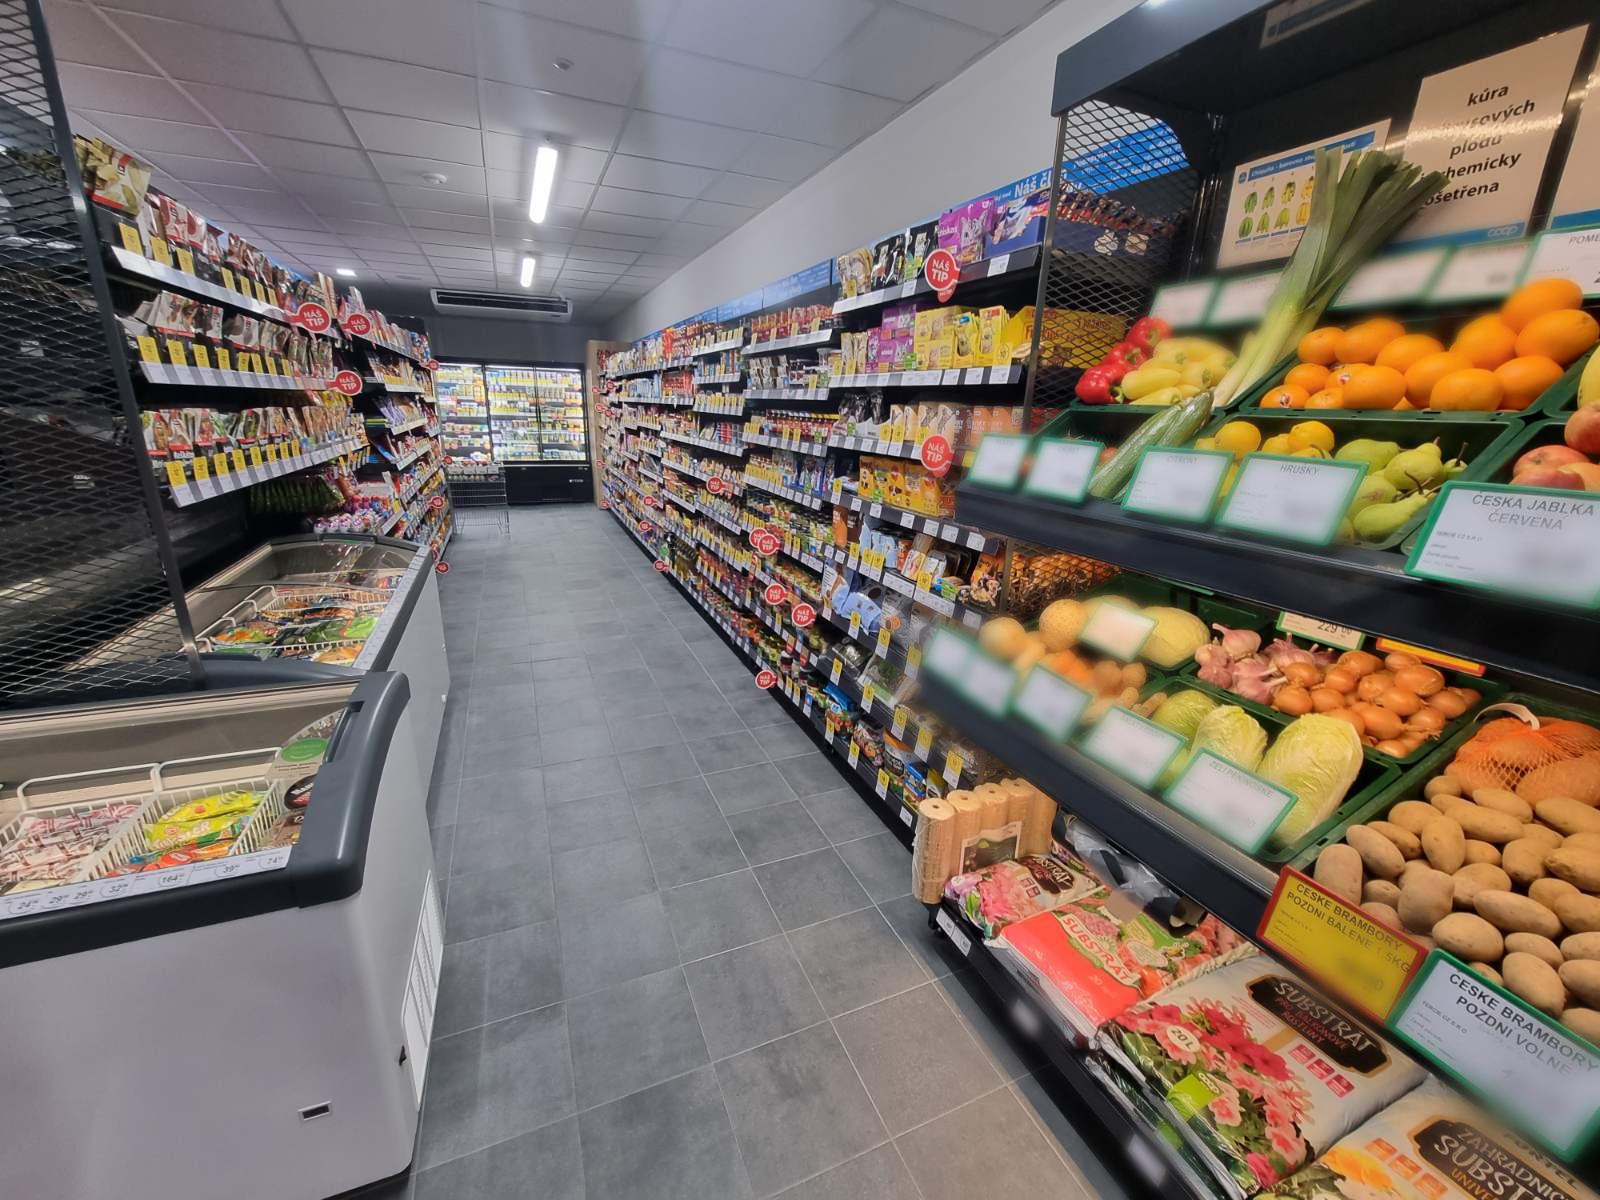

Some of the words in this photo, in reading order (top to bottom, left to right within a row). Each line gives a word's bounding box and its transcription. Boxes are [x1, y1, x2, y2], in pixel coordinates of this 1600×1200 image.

[1467, 86, 1509, 106] kúra
[1015, 175, 1037, 198] Náš
[932, 268, 949, 282] TIP
[933, 259, 950, 271] NÁŠ
[306, 317, 325, 327] TIP
[341, 382, 357, 390] TIP
[927, 450, 943, 463] TIP
[1526, 500, 1595, 517] JABLKA
[1333, 907, 1403, 952] BRAMBORY
[1274, 981, 1377, 1051] SUBSTRÁT
[1171, 1028, 1188, 1042] 20
[1185, 1041, 1194, 1050] L
[1501, 1006, 1600, 1072] BRAMBORY
[1434, 1135, 1543, 1200] SUBST
[1457, 1128, 1570, 1200] ZAHRADNIC
[1451, 1168, 1499, 1200] UNIVE
